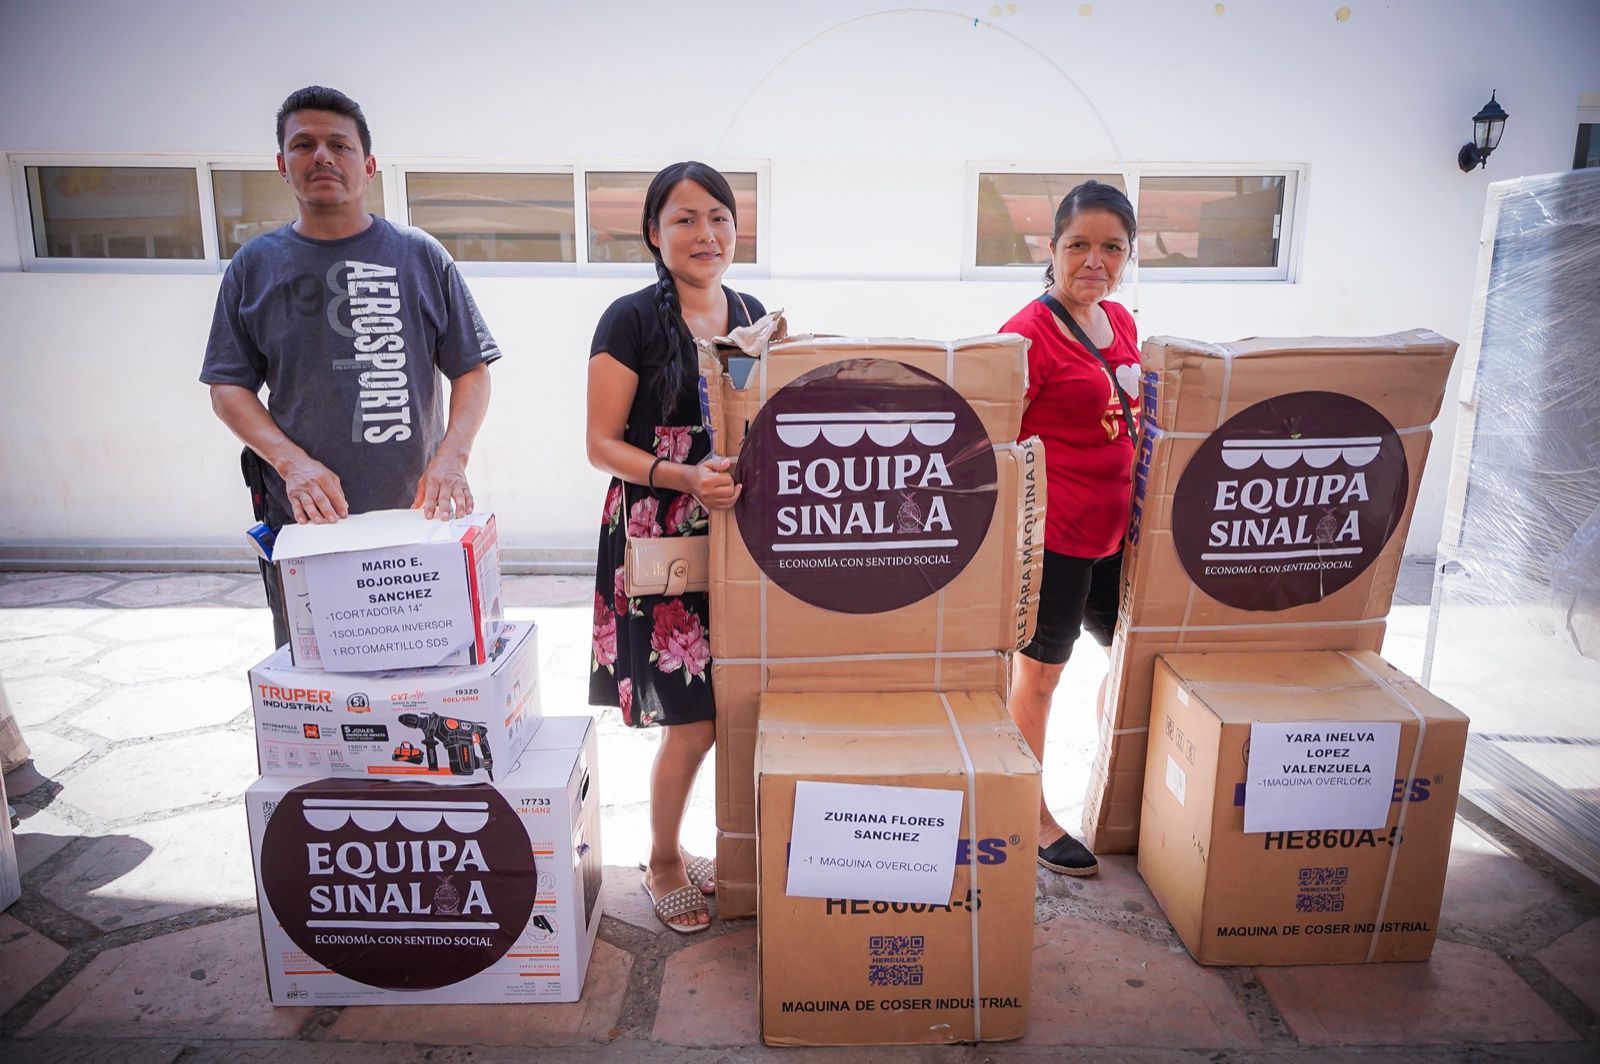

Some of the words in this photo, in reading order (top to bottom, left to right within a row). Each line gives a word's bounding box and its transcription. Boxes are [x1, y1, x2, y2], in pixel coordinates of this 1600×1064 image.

[345, 260, 412, 444] AEROSPORTS
[777, 453, 953, 498] EQUIPA
[1213, 472, 1369, 513] EQUIPA
[362, 558, 406, 572] MARIO
[410, 557, 423, 567] E.
[779, 556, 839, 568] ECONOMÍA
[840, 558, 864, 567] CON
[866, 557, 912, 567] SENTIDO
[914, 555, 951, 565] SOCIAL
[1205, 564, 1257, 575] ECONOMÍA
[1259, 566, 1280, 574] CON
[1282, 563, 1321, 573] SENTIDO
[1322, 560, 1353, 570] SOCIAL
[356, 571, 440, 589] BOJORQUEZ
[368, 588, 432, 604] SANCHEZ
[1019, 569, 1031, 616] PARA
[402, 619, 453, 632] INVERSOR
[340, 640, 424, 656] ROTOMARTILLO
[426, 637, 449, 648] SDS
[258, 685, 332, 704] TRUPER
[263, 699, 333, 713] INDUSTRIAL
[1286, 733, 1320, 743] YARA
[1326, 733, 1374, 742] INELVA
[1307, 748, 1350, 758] LOPEZ
[1283, 764, 1371, 773] VALENZUELA
[1315, 777, 1372, 786] OVERLOCK
[824, 811, 887, 824] ZURIANA
[891, 815, 945, 827] FLORES
[854, 830, 920, 842] SANCHEZ
[1264, 829, 1404, 850] HE860A-5
[306, 840, 489, 878] EQUIPA
[803, 856, 813, 864] -1
[820, 857, 872, 868] MAQUINA
[875, 860, 938, 872] OVERLOCK
[1217, 926, 1278, 937] MAQUINA
[1282, 925, 1300, 935] DE
[1304, 924, 1350, 935] COSER
[315, 934, 376, 944] ECONOMÍA
[378, 935, 403, 944] CON
[404, 936, 452, 945] SENTIDO
[454, 936, 493, 947] SOCIAL
[782, 1000, 850, 1012] MAQUINA
[855, 1000, 875, 1010] DE
[880, 999, 931, 1010] COSER
